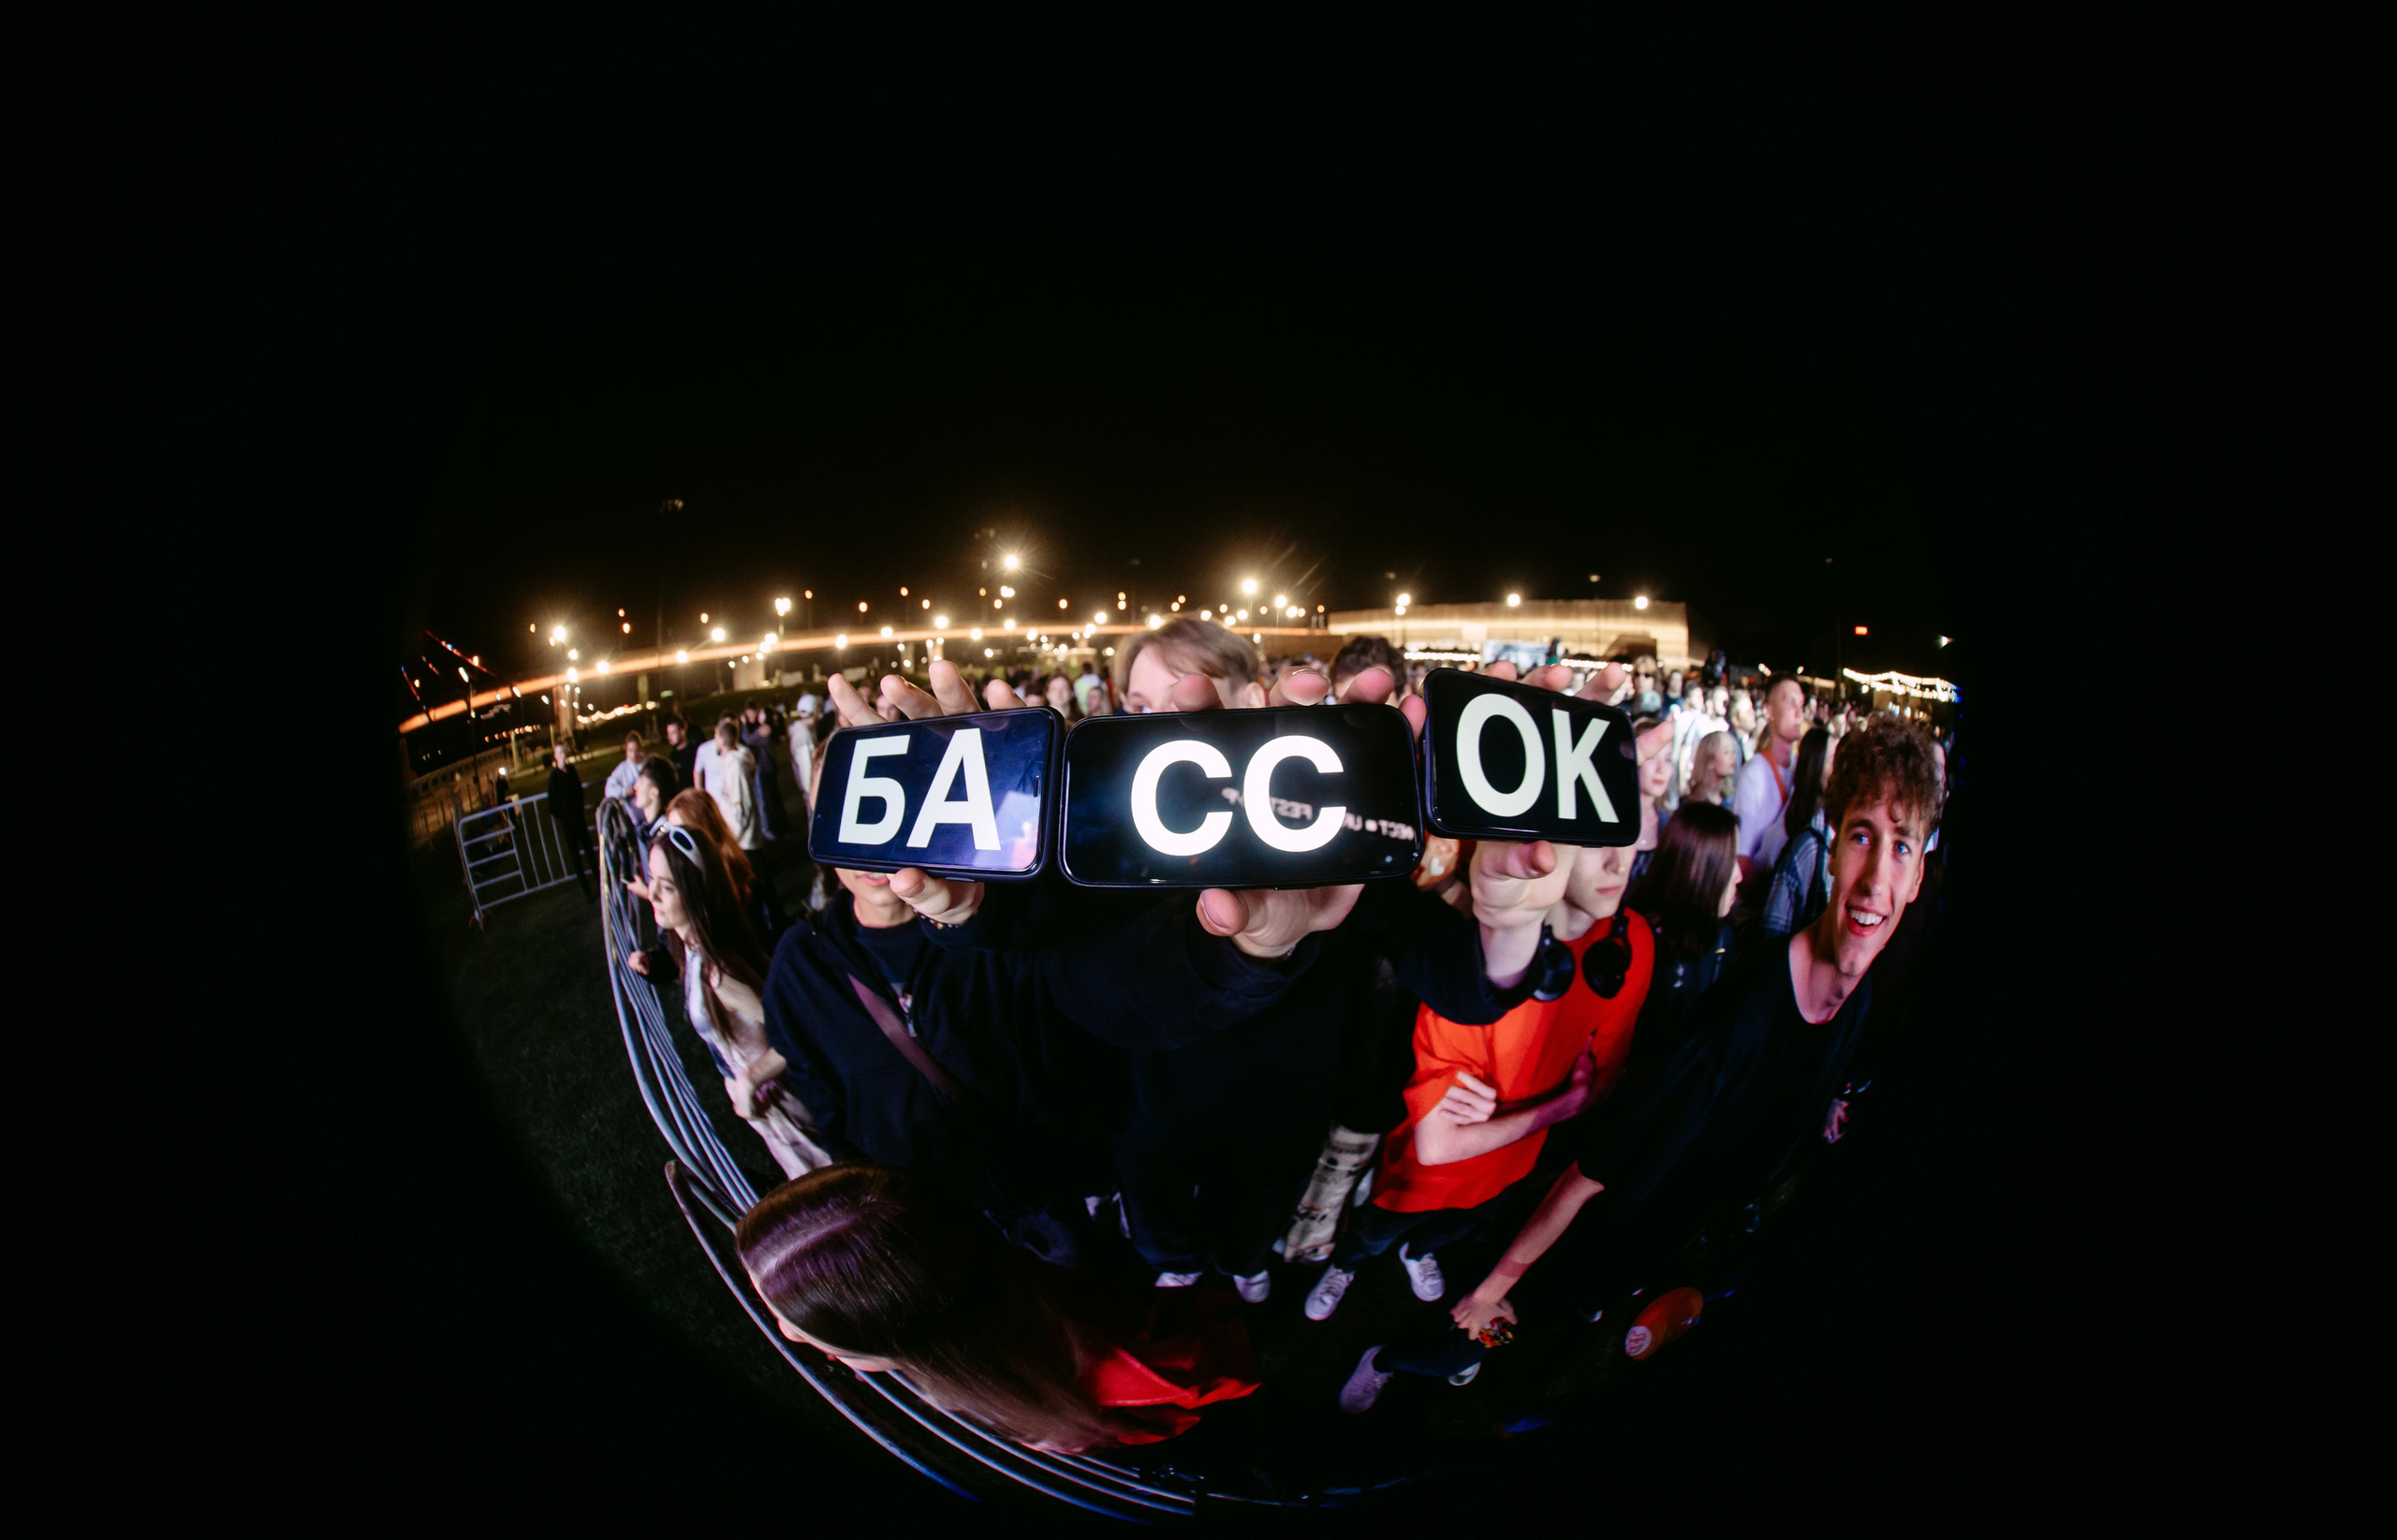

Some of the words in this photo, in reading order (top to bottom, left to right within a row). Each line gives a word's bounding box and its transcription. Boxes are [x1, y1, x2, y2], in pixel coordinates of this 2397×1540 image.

[838, 727, 1001, 851] БА
[1130, 735, 1347, 857] СС
[1456, 693, 1620, 823] ОК
